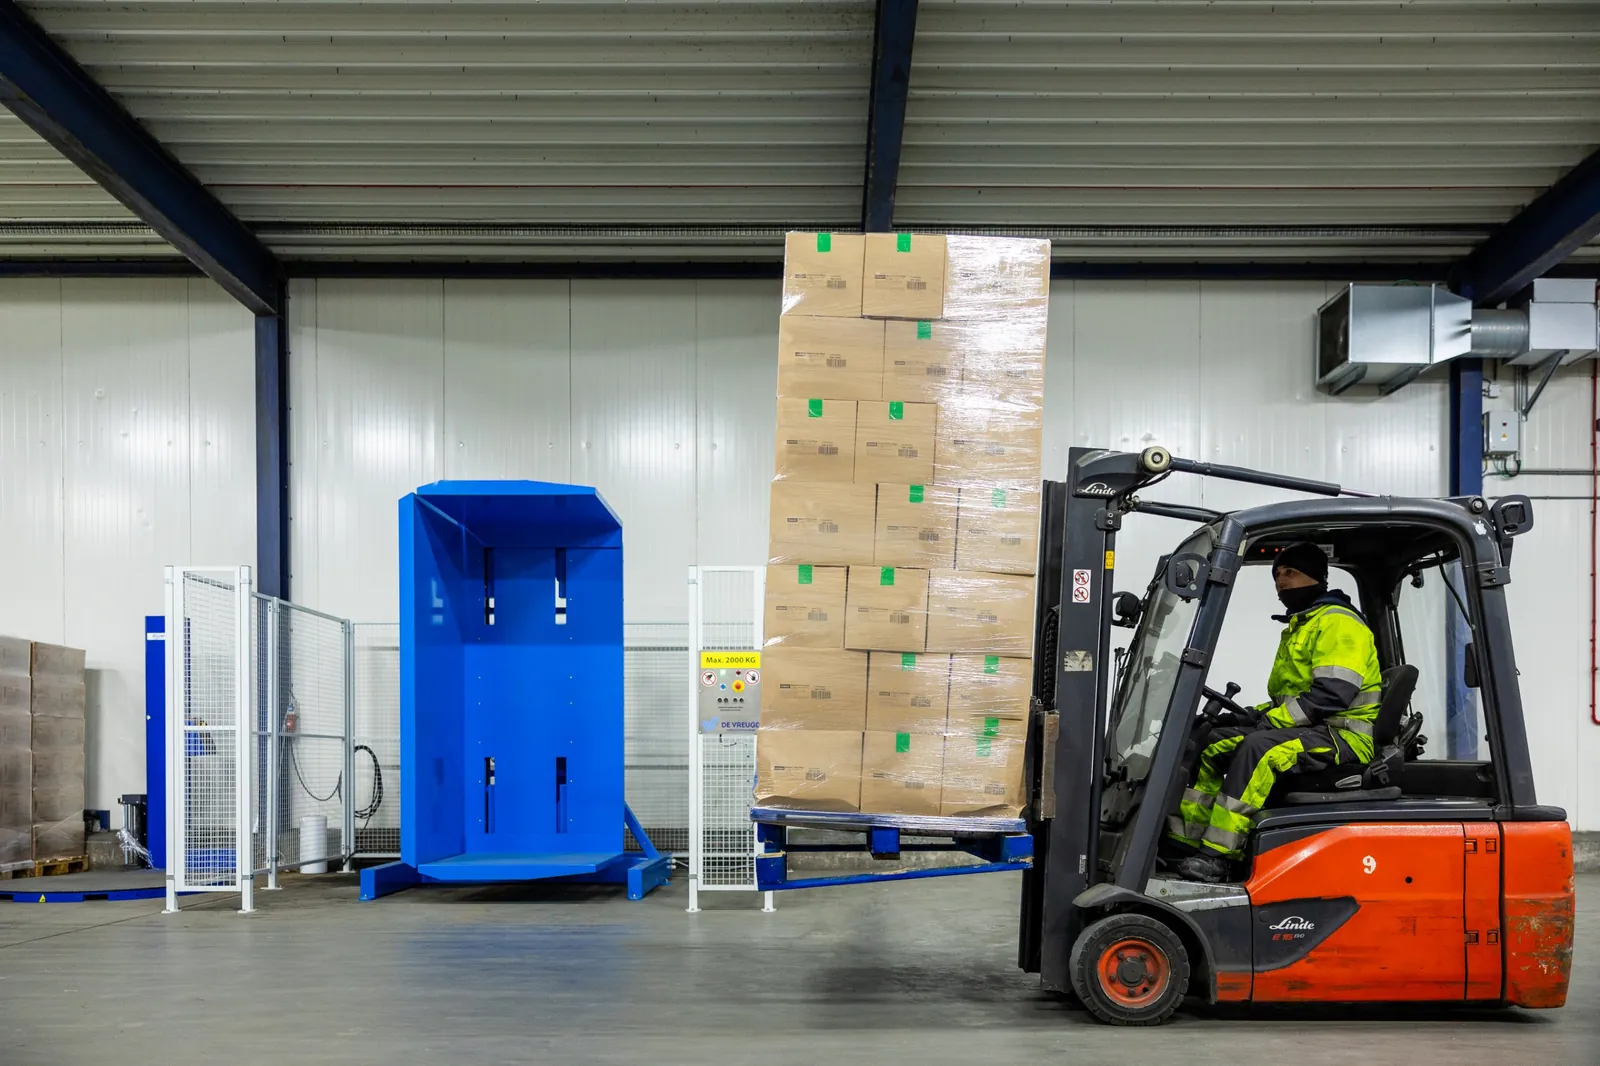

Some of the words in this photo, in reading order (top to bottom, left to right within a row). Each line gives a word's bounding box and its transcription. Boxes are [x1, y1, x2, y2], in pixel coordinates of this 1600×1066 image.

[1077, 482, 1117, 496] Linde
[1362, 855, 1377, 874] 9
[1269, 916, 1315, 930] Linde
